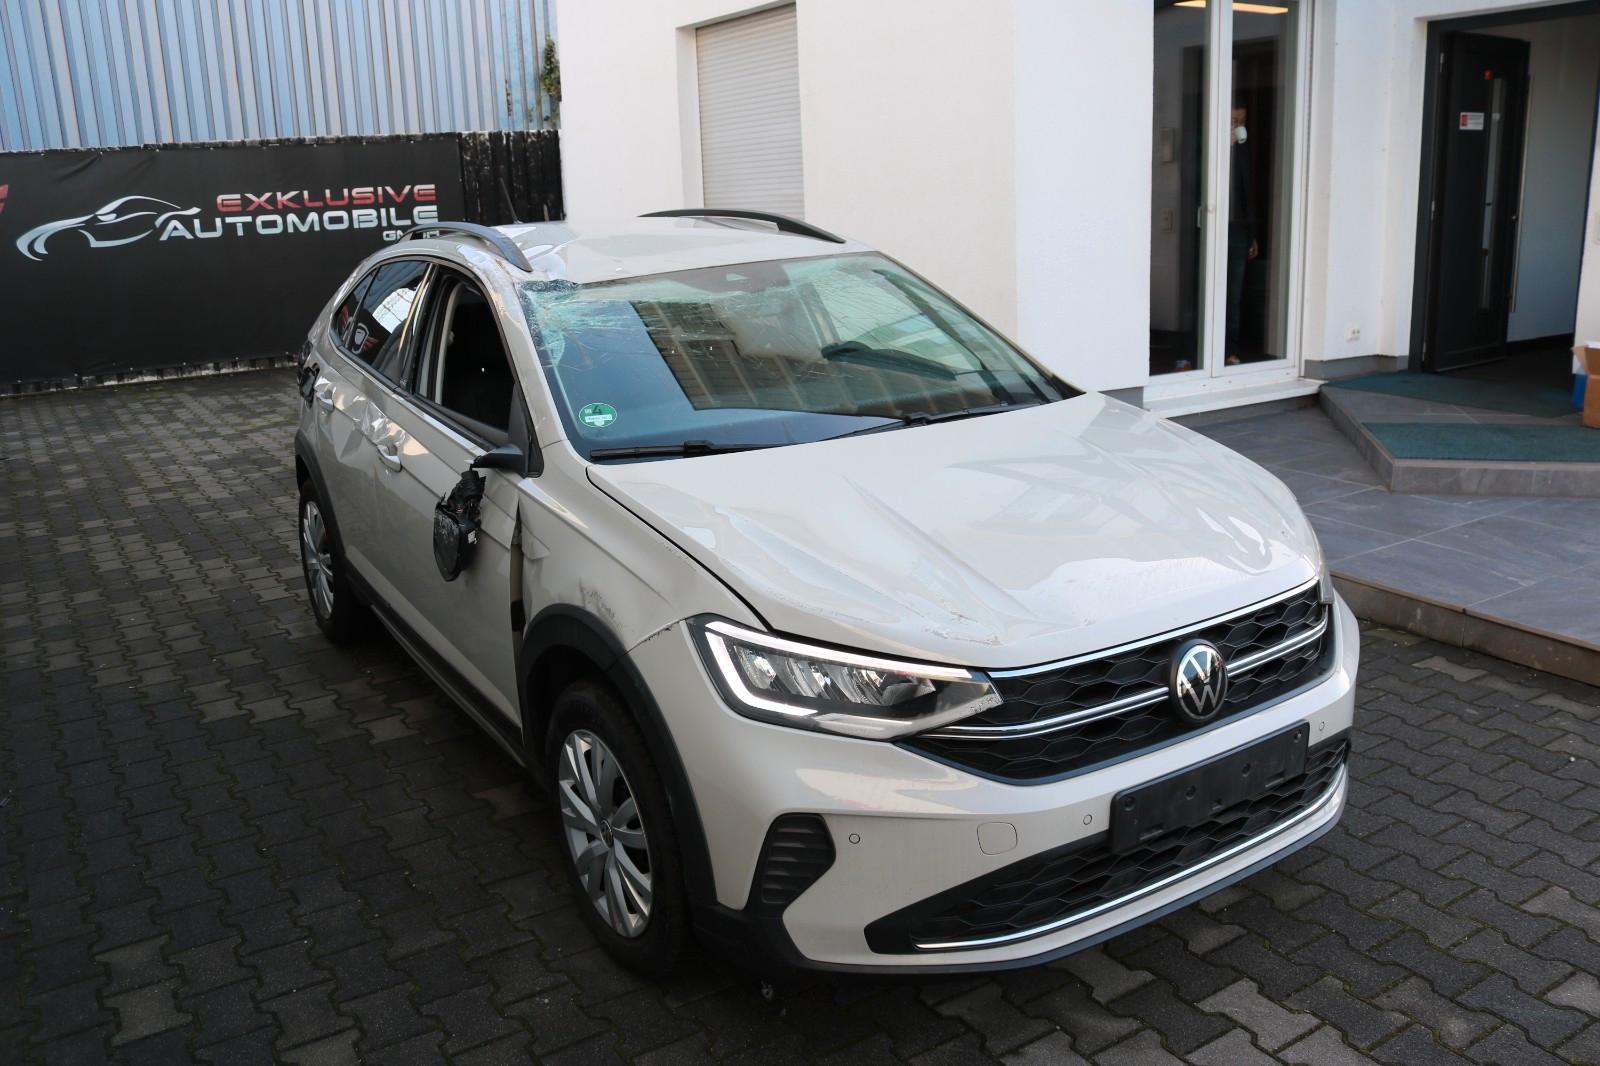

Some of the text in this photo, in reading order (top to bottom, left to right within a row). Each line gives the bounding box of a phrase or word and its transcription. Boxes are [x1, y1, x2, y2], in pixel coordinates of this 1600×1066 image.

[217, 184, 436, 212] EXKLUSIVE
[160, 205, 438, 240] AUTOMOBILE
[592, 405, 603, 416] 4
[1179, 648, 1222, 714] VW
